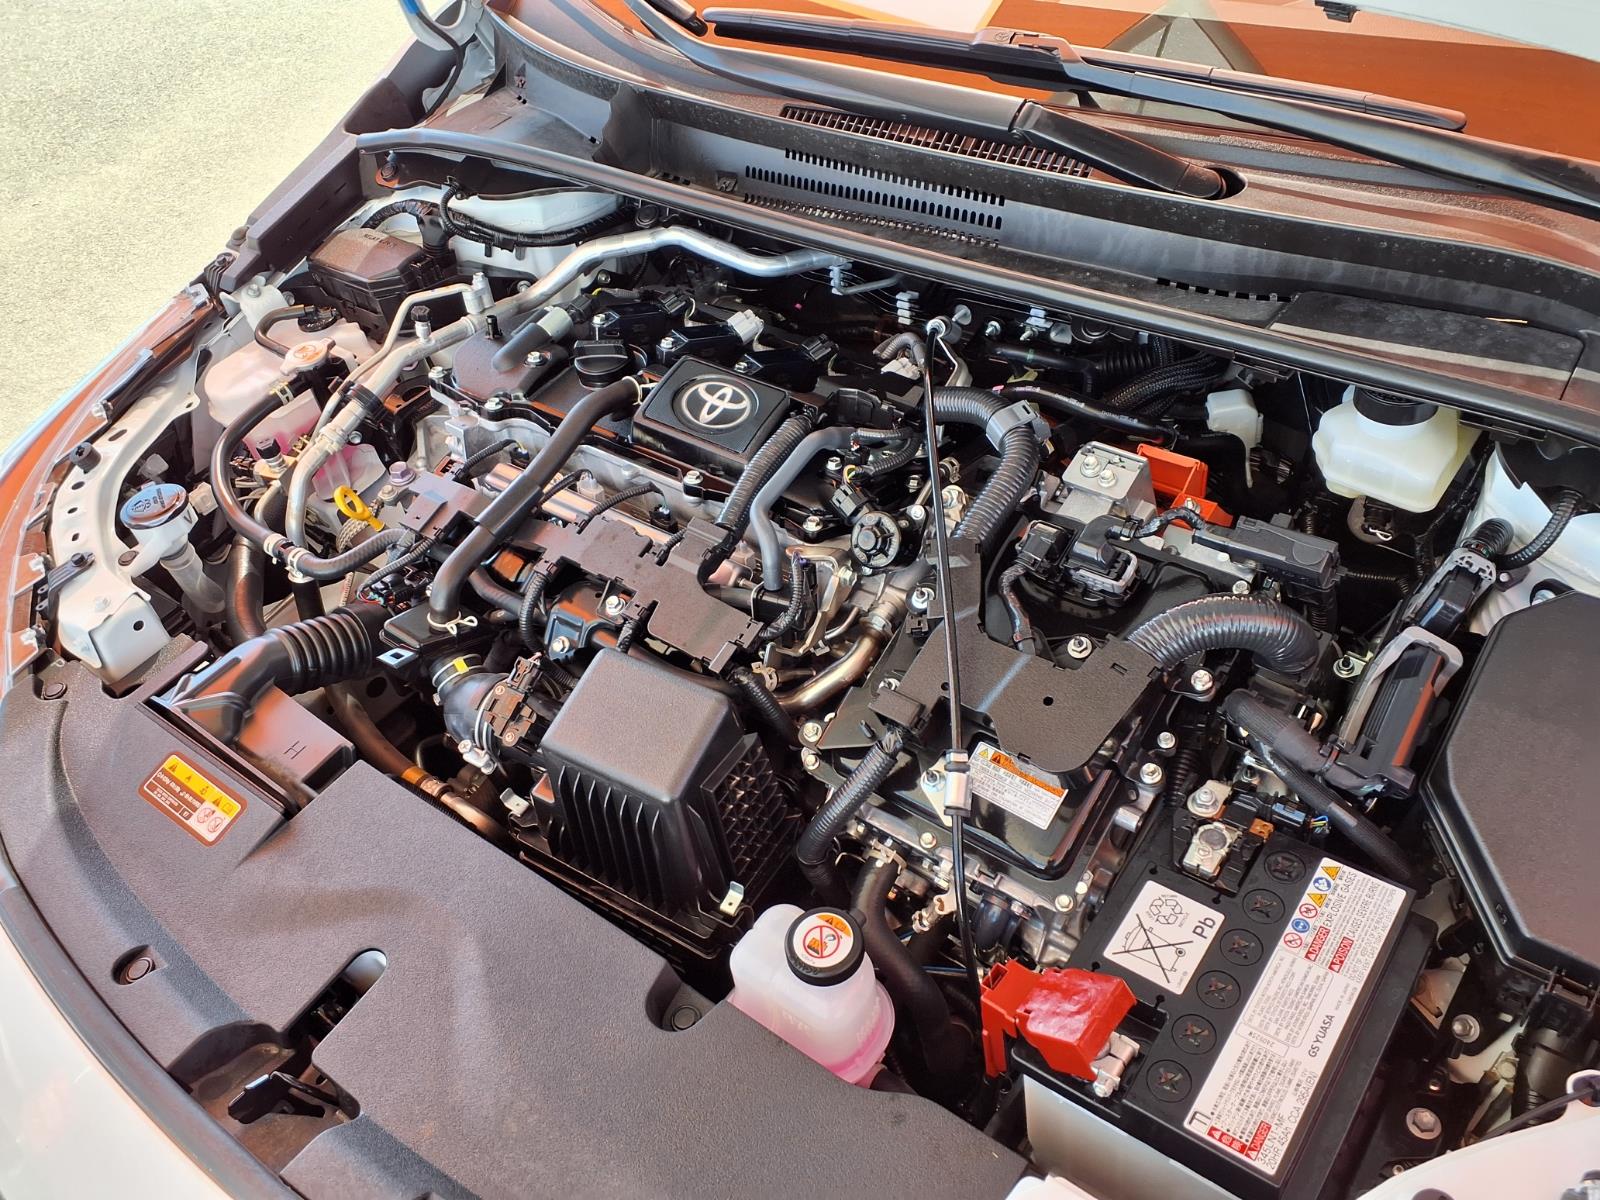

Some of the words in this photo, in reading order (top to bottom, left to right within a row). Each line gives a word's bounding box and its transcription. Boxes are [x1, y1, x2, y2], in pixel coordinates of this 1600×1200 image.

[1191, 913, 1216, 940] Pb
[1308, 926, 1329, 954] DANGER
[1321, 892, 1346, 928] EXPLOSIVE
[1339, 870, 1357, 893] GASES
[1332, 937, 1352, 965] POISON
[1345, 916, 1363, 938] CAUSES
[1355, 897, 1372, 918] SEVERE
[1364, 880, 1380, 900] BURNS
[1313, 1012, 1335, 1046] YUASA
[1307, 1043, 1320, 1058] GS
[1276, 1124, 1292, 1147] 45Ah
[1287, 1104, 1302, 1124] CCA
[1295, 1070, 1319, 1106] 295A(EN)
[1250, 1122, 1270, 1151] DANGER
